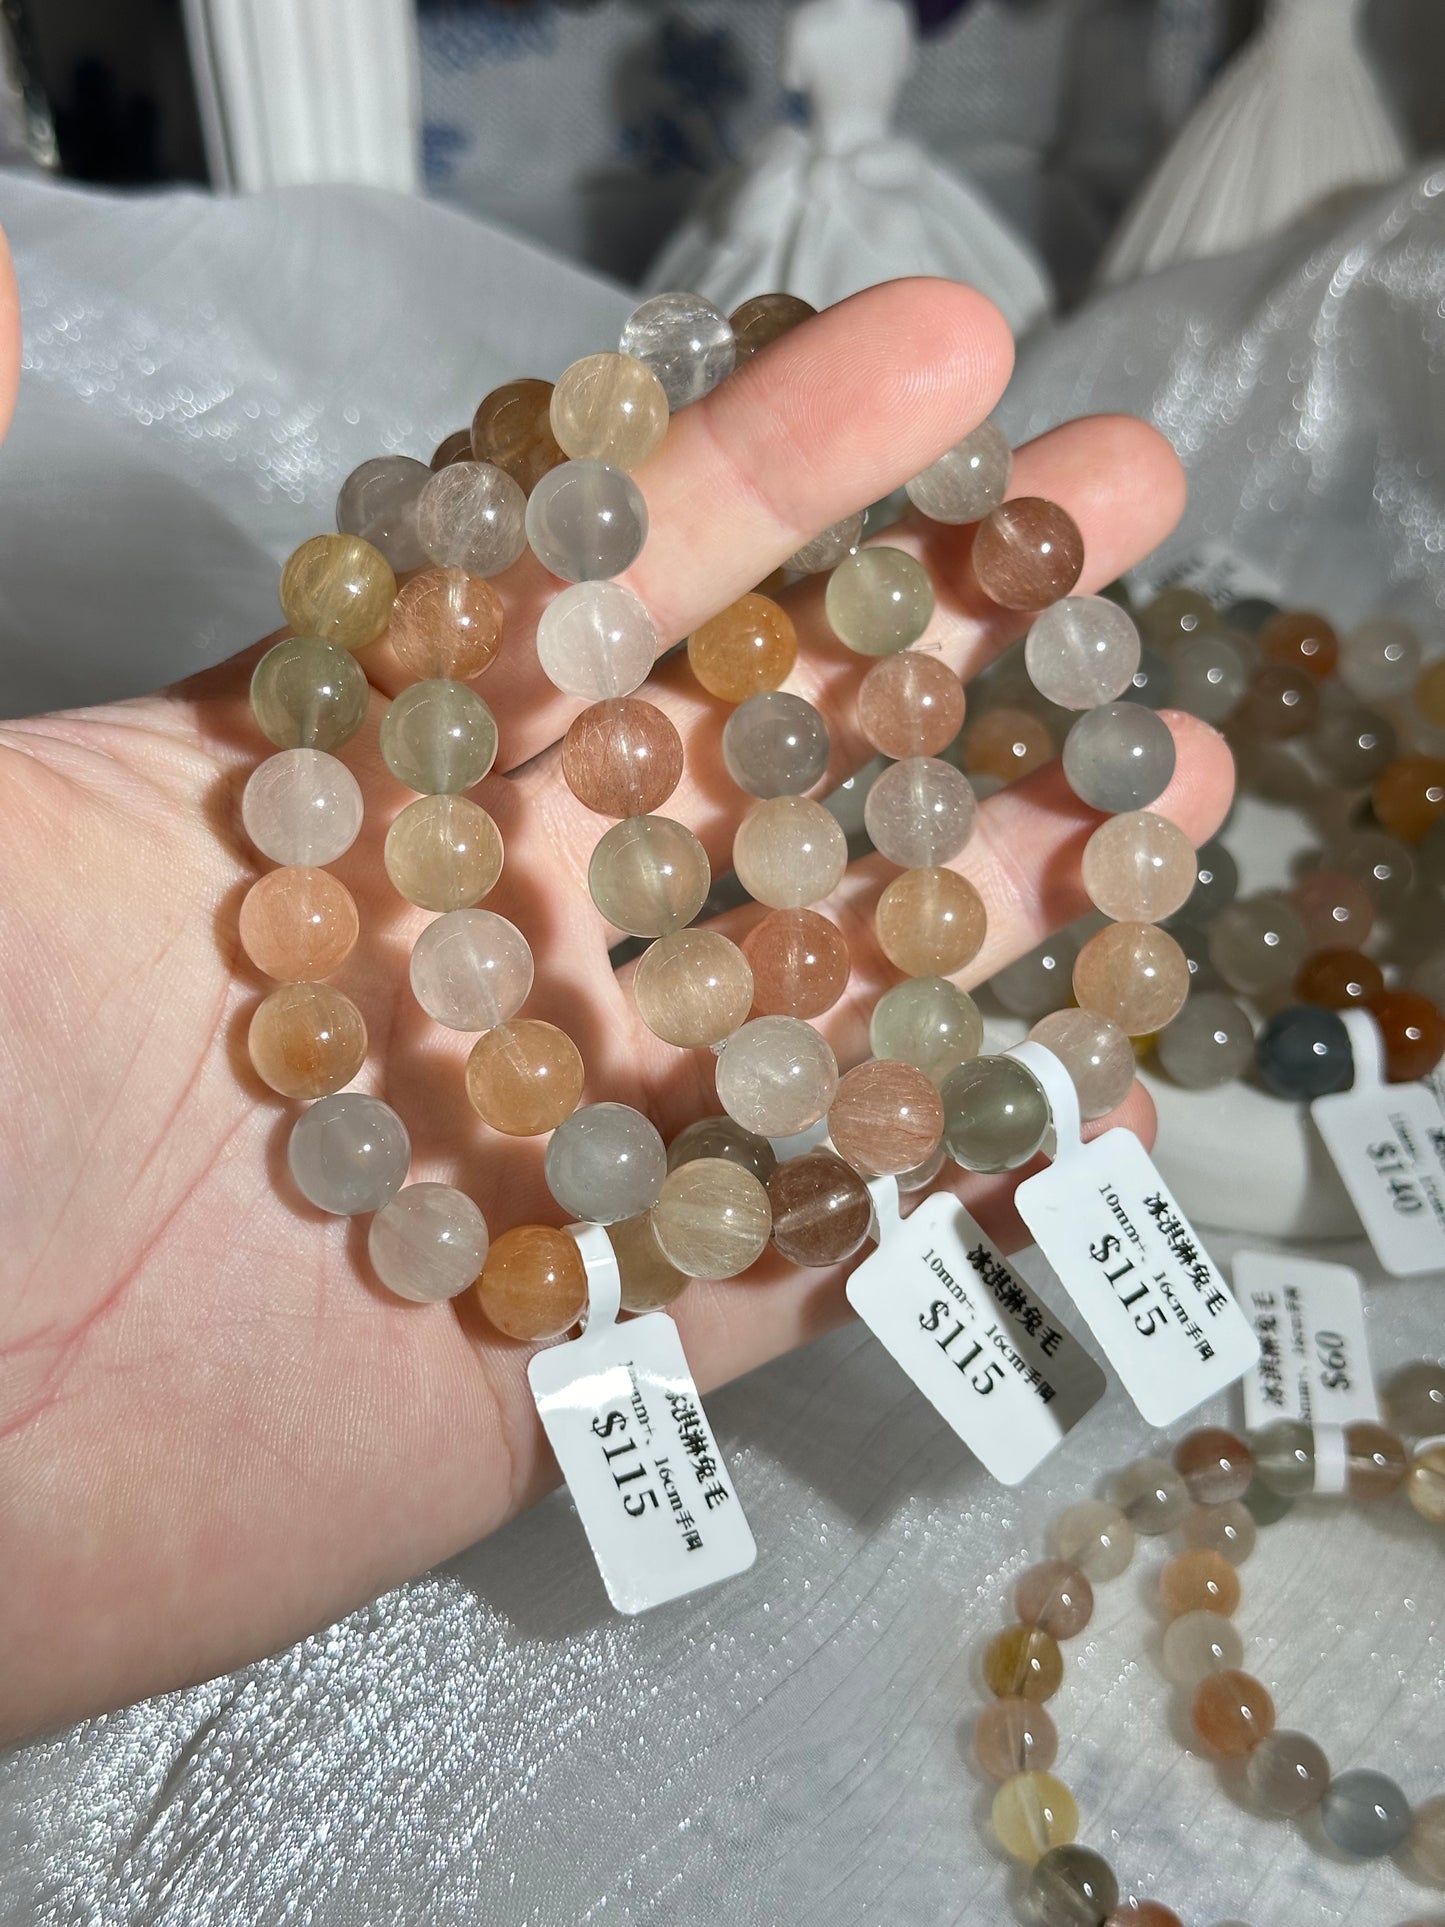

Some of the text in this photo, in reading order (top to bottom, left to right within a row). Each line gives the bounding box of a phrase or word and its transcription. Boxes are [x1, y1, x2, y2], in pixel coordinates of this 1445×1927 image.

[966, 1243, 1063, 1358] 冰淇淋兔毛
[1089, 1233, 1168, 1337] $115
[1142, 1191, 1228, 1317] 冰淇淋兔毛
[918, 1299, 1005, 1395] $115
[1314, 1330, 1350, 1391] $60
[590, 1410, 660, 1517] $115
